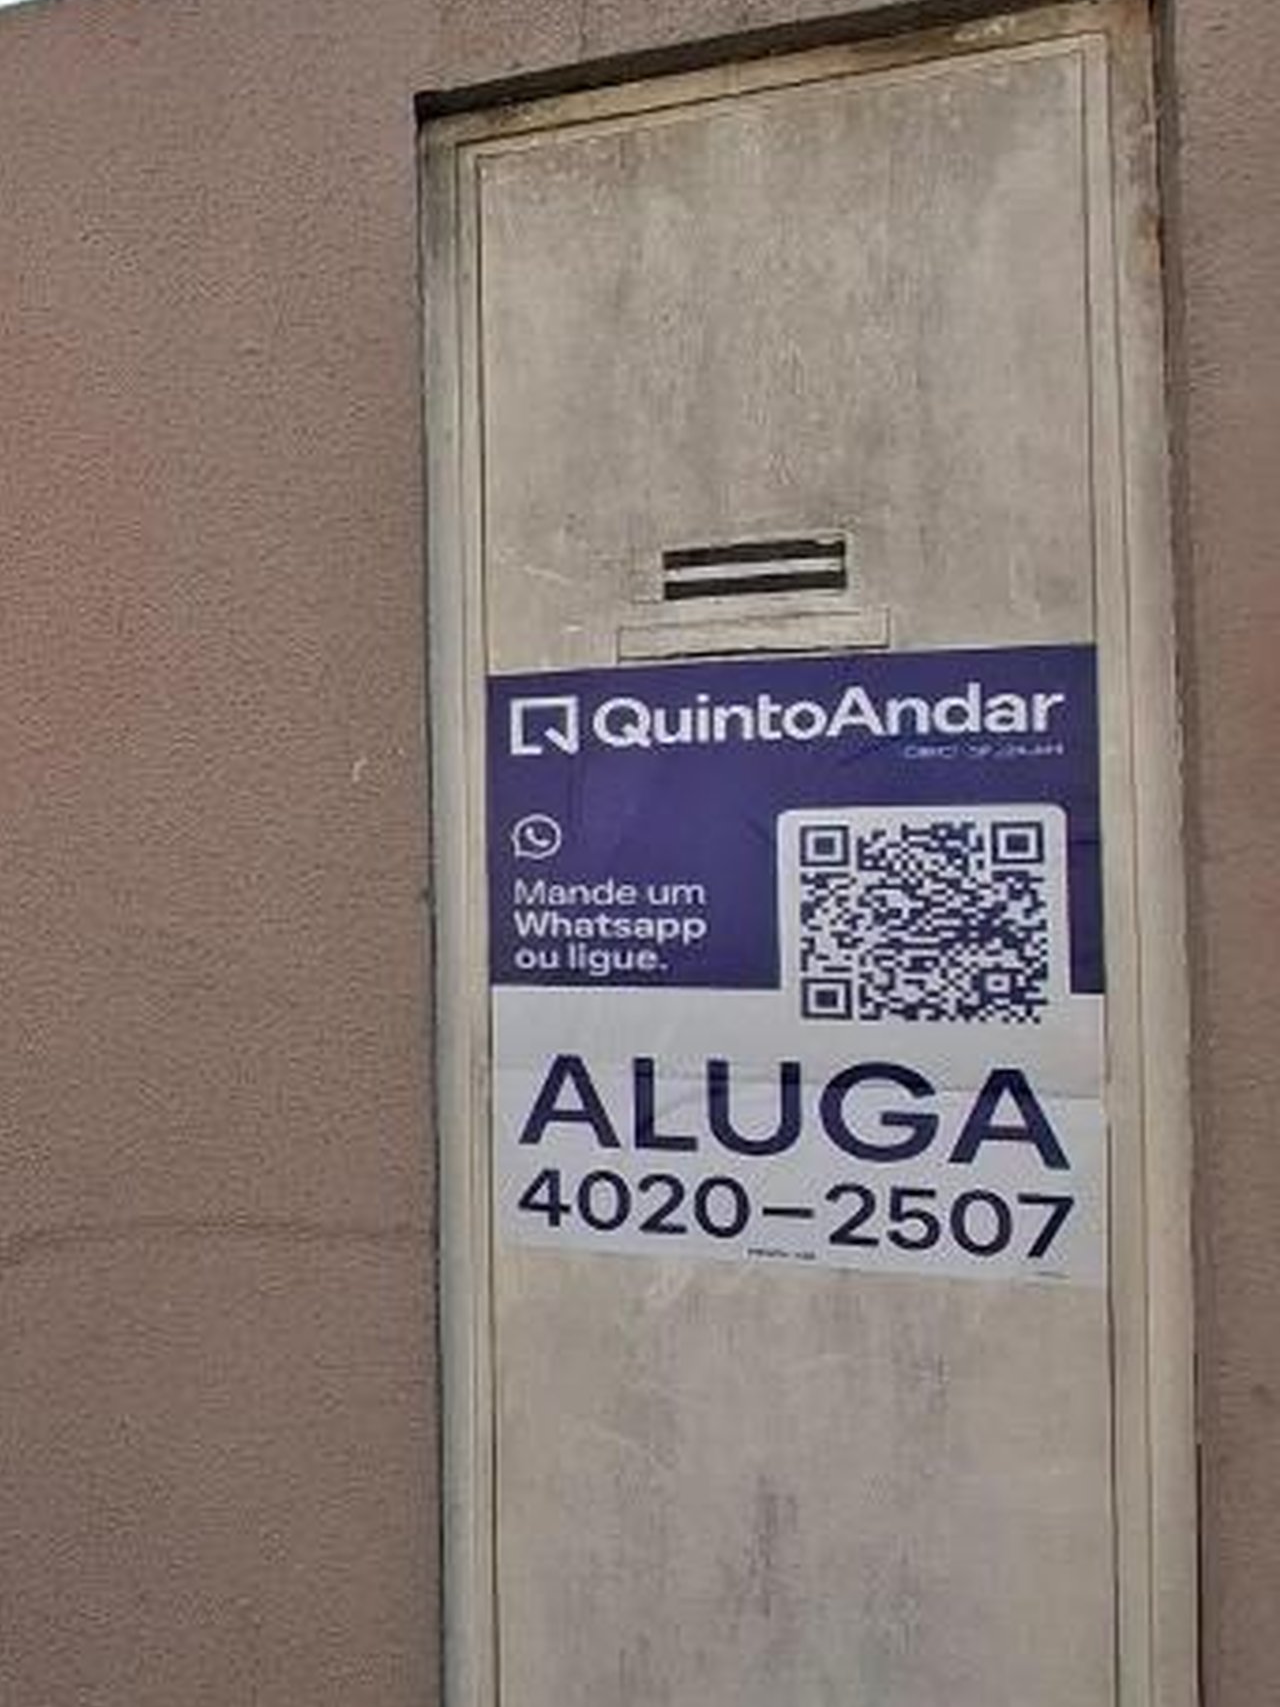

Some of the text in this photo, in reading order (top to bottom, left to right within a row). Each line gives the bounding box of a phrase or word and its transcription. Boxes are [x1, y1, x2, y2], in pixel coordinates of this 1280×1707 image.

[593, 682, 1065, 747] QuintoAndar
[514, 878, 707, 907] Mande um
[514, 911, 708, 944] Whatsapp
[515, 944, 668, 977] ou ligue.
[518, 1053, 1072, 1170] ALUGA
[517, 1168, 1076, 1260] 4020-2507
